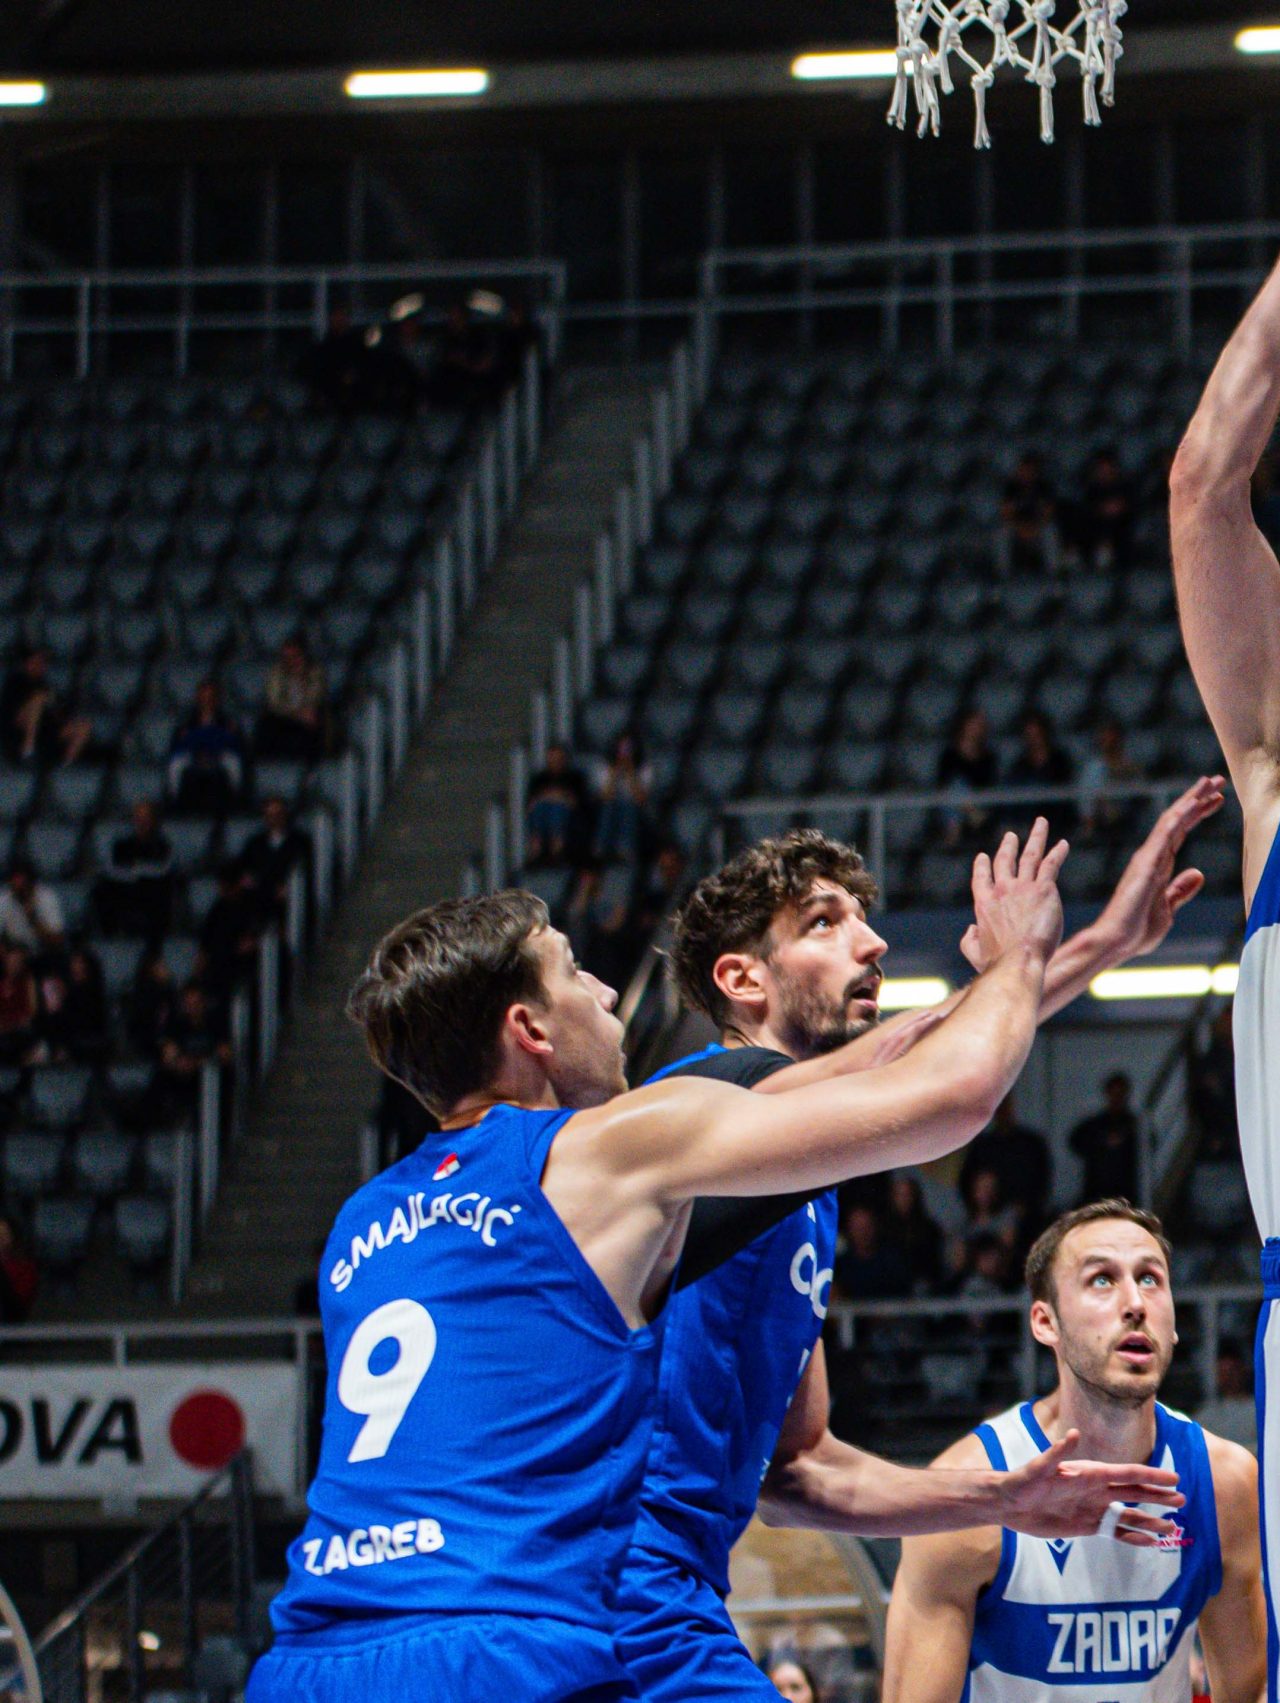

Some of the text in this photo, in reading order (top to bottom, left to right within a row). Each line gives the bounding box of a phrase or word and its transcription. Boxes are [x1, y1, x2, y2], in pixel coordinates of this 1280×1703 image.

[329, 1192, 522, 1293] SMAJLAGIĆ
[337, 1298, 438, 1464] 9
[302, 1518, 446, 1576] ZAGREB
[1047, 1607, 1182, 1674] ZADAR
